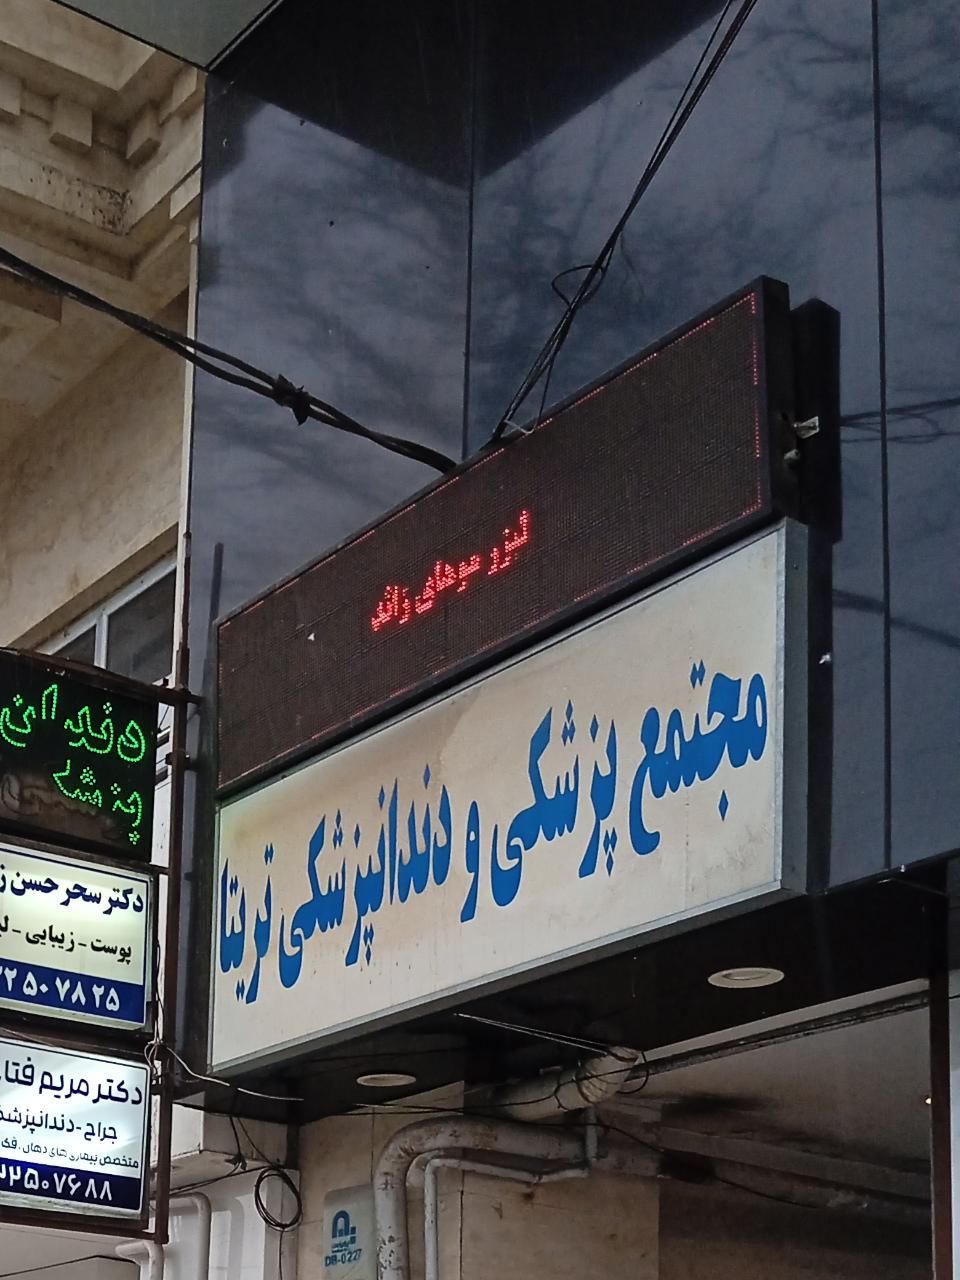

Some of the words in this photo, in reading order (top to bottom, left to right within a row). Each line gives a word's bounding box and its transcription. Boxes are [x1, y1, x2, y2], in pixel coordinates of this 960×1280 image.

[488, 510, 528, 575] لیزر
[415, 554, 481, 614] موهای
[629, 659, 768, 856] مجتمع
[490, 699, 617, 907] پزشکی
[460, 800, 480, 923] و
[60, 883, 101, 906] سحر
[103, 888, 144, 914] دکتر
[26, 925, 75, 951] زیبایی
[90, 939, 132, 964] پوست
[39, 1070, 89, 1099] مریم
[92, 1078, 142, 1105] دکتر
[83, 1121, 118, 1144] جراح
[99, 1155, 139, 1169] متخصص
